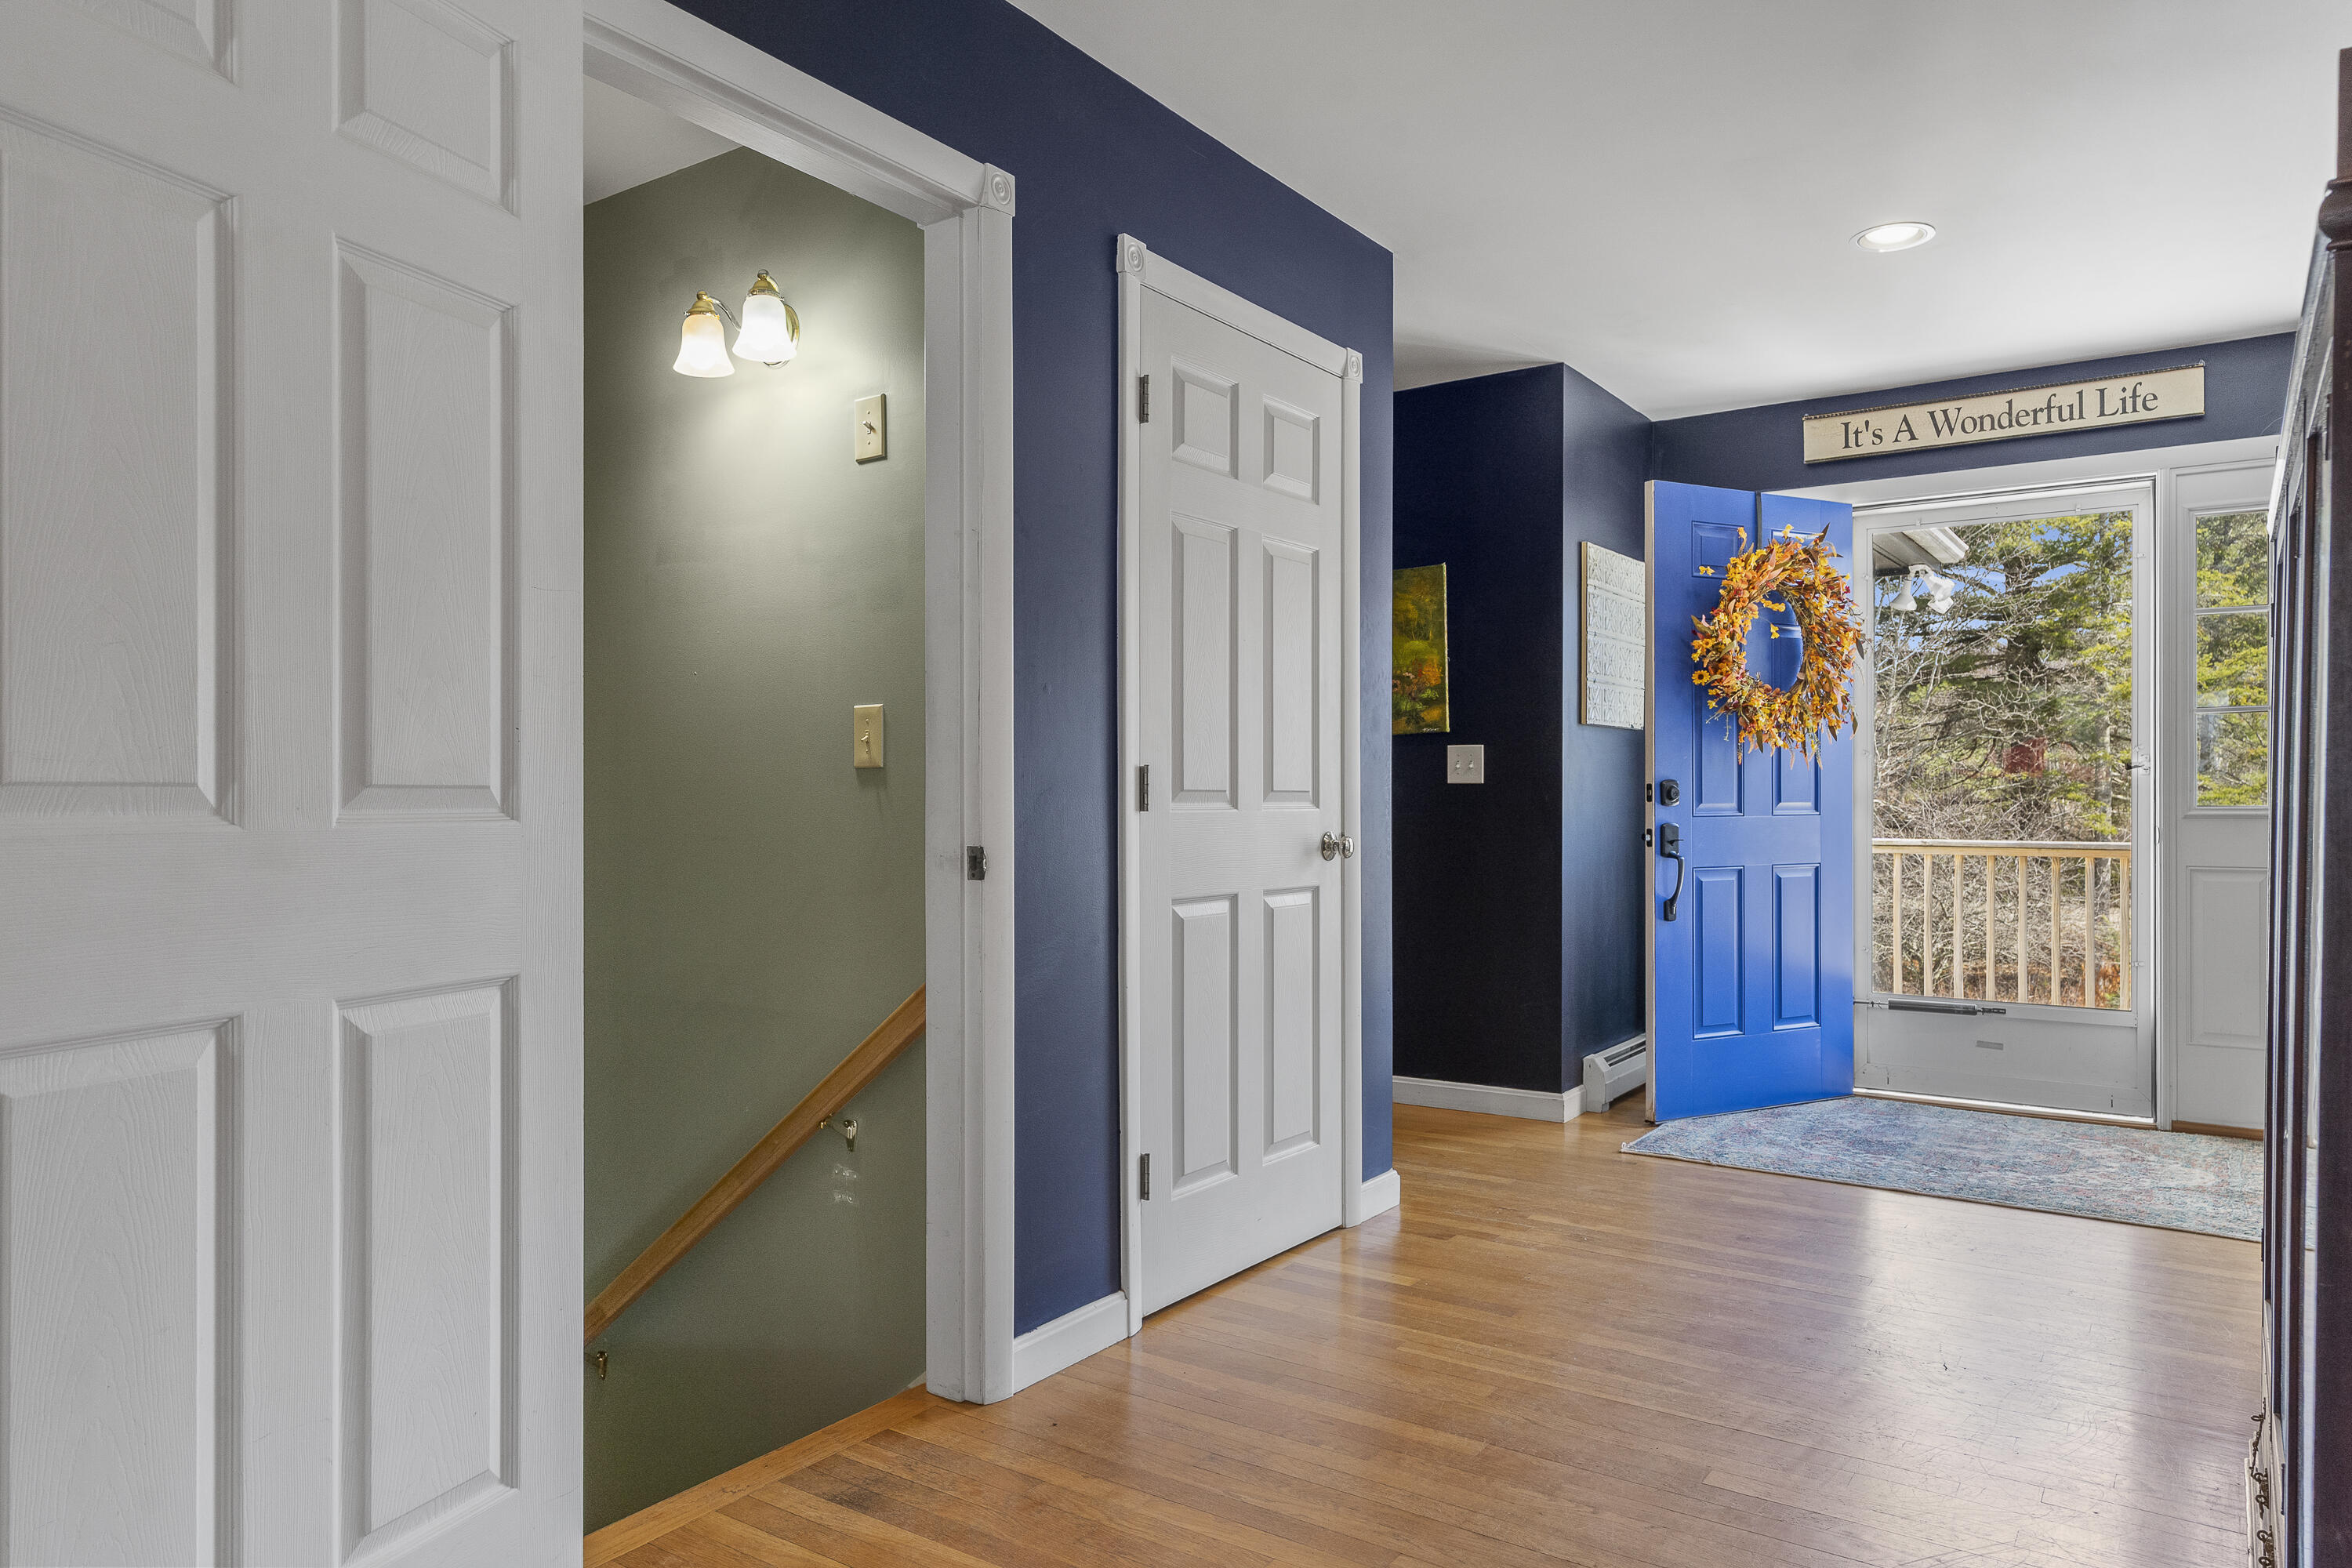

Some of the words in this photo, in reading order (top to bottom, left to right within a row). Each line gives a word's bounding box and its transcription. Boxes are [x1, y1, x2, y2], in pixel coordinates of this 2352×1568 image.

[1840, 420, 1883, 449] It's
[1892, 413, 1920, 444] A
[1926, 388, 2086, 439] Wonderful
[2095, 381, 2158, 418] Life
